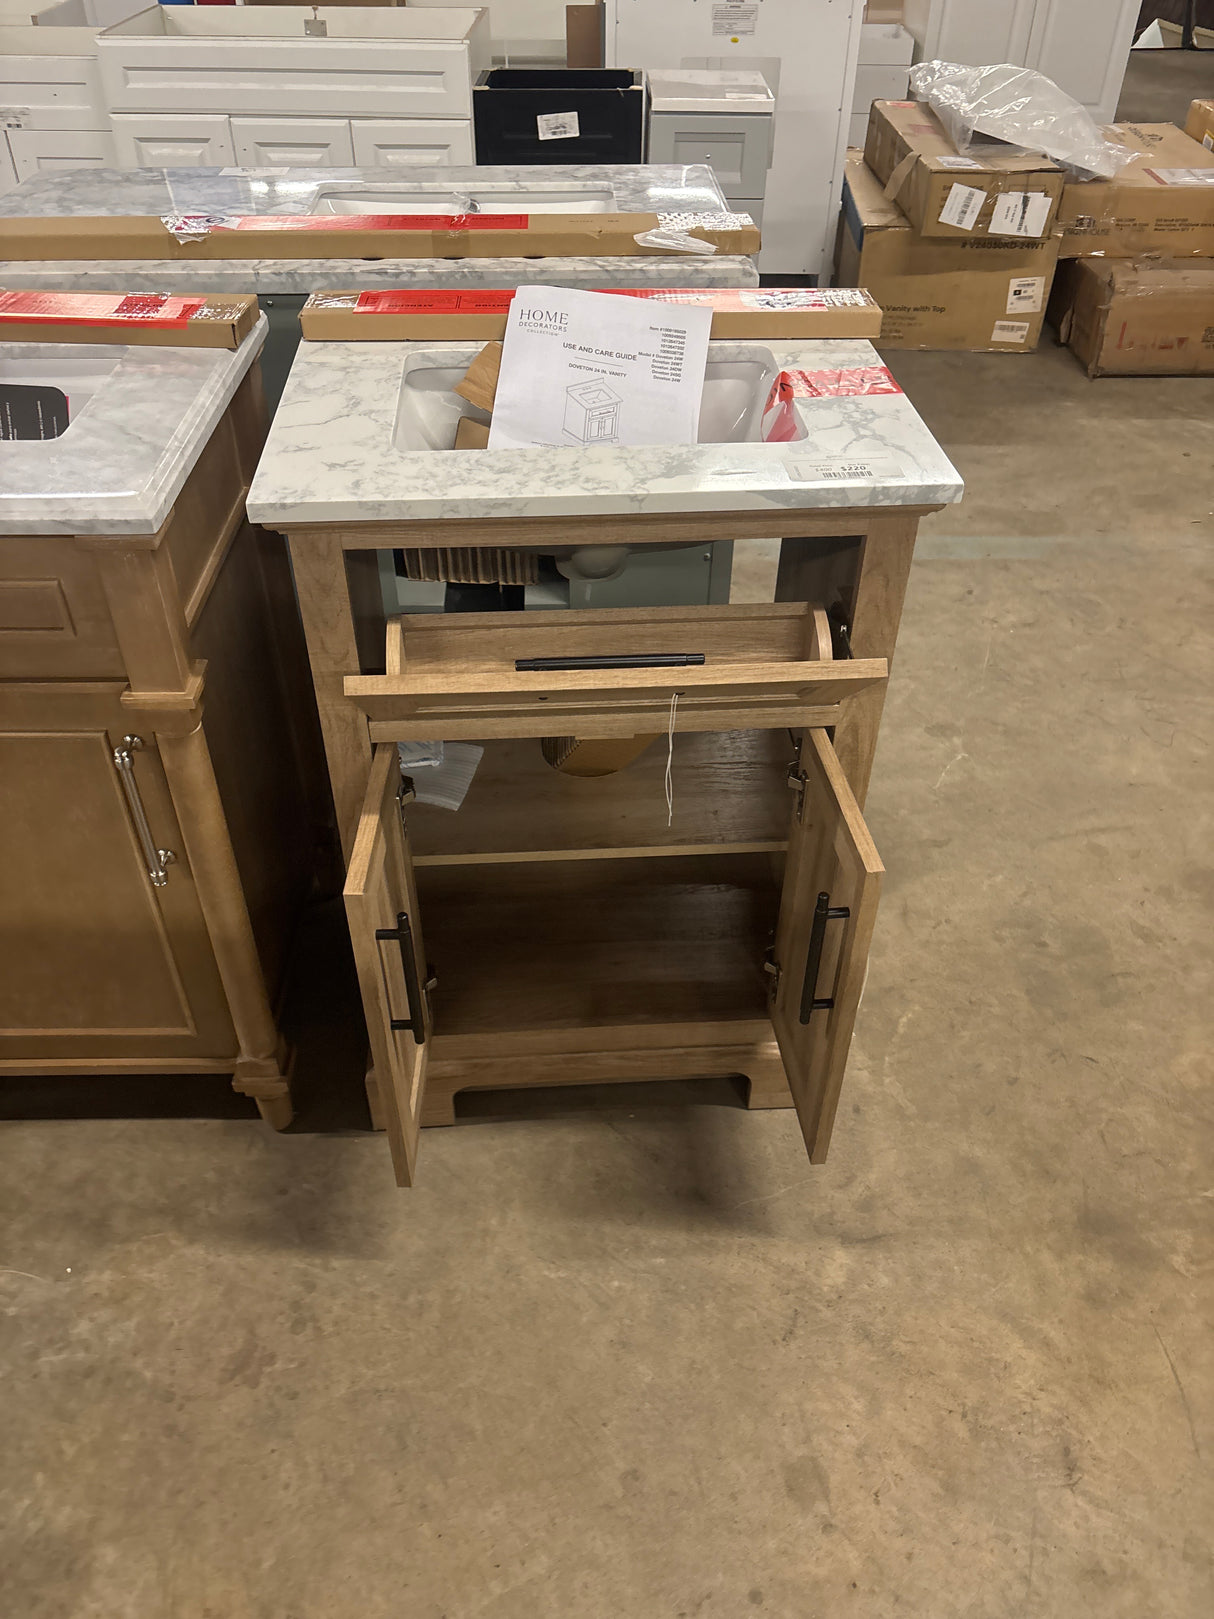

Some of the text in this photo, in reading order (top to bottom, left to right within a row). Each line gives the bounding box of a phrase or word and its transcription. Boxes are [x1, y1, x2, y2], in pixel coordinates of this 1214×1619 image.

[519, 308, 569, 326] HOME
[885, 305, 911, 313] Vanity
[931, 305, 946, 314] Top
[518, 321, 567, 333] DECORATORS
[562, 342, 638, 361] USE AND CARE GUIDE
[568, 362, 594, 372] DOVETON
[608, 370, 628, 378] VANITY
